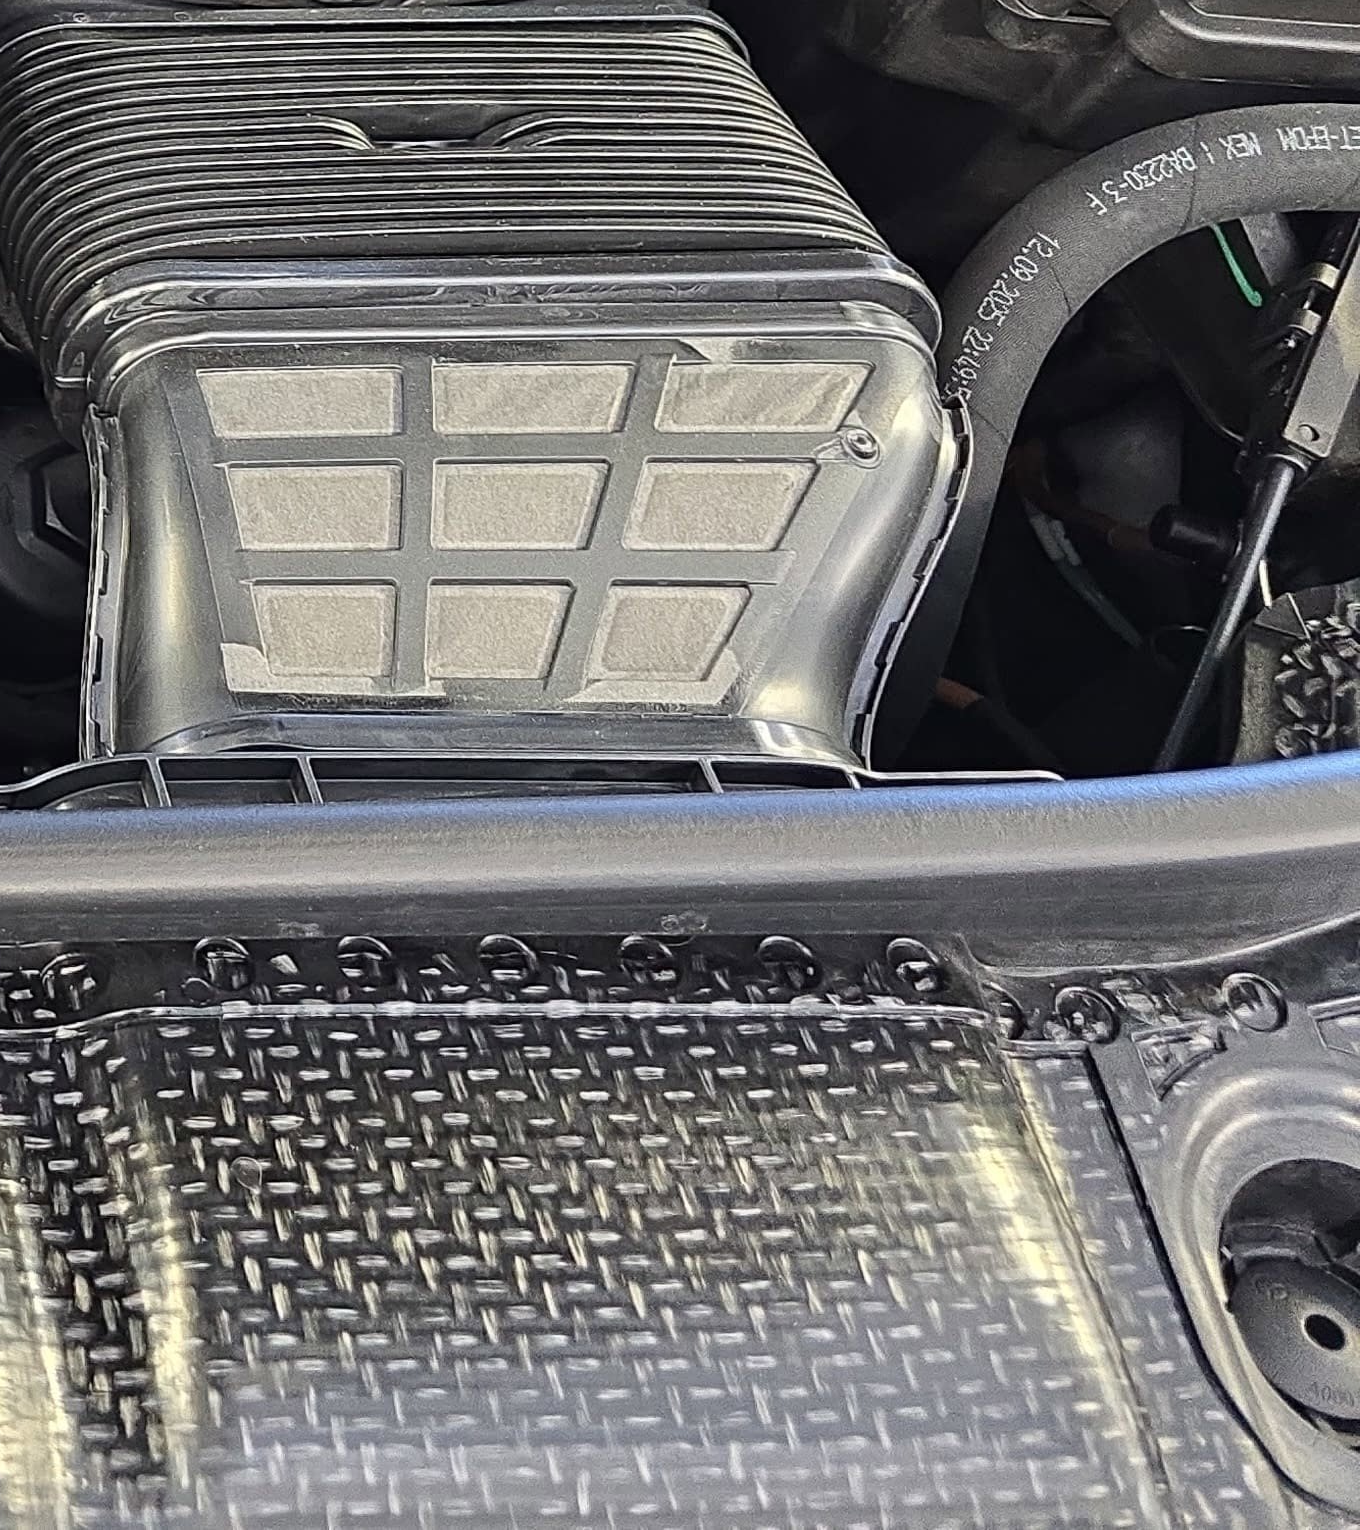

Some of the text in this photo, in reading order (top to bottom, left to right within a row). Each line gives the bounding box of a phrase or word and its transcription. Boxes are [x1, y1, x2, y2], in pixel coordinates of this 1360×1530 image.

[1218, 131, 1263, 160] MEX
[1101, 146, 1197, 204] BA2230-3
[1085, 190, 1108, 216] F
[941, 231, 1062, 402] 12.09.2025 22:49:5
